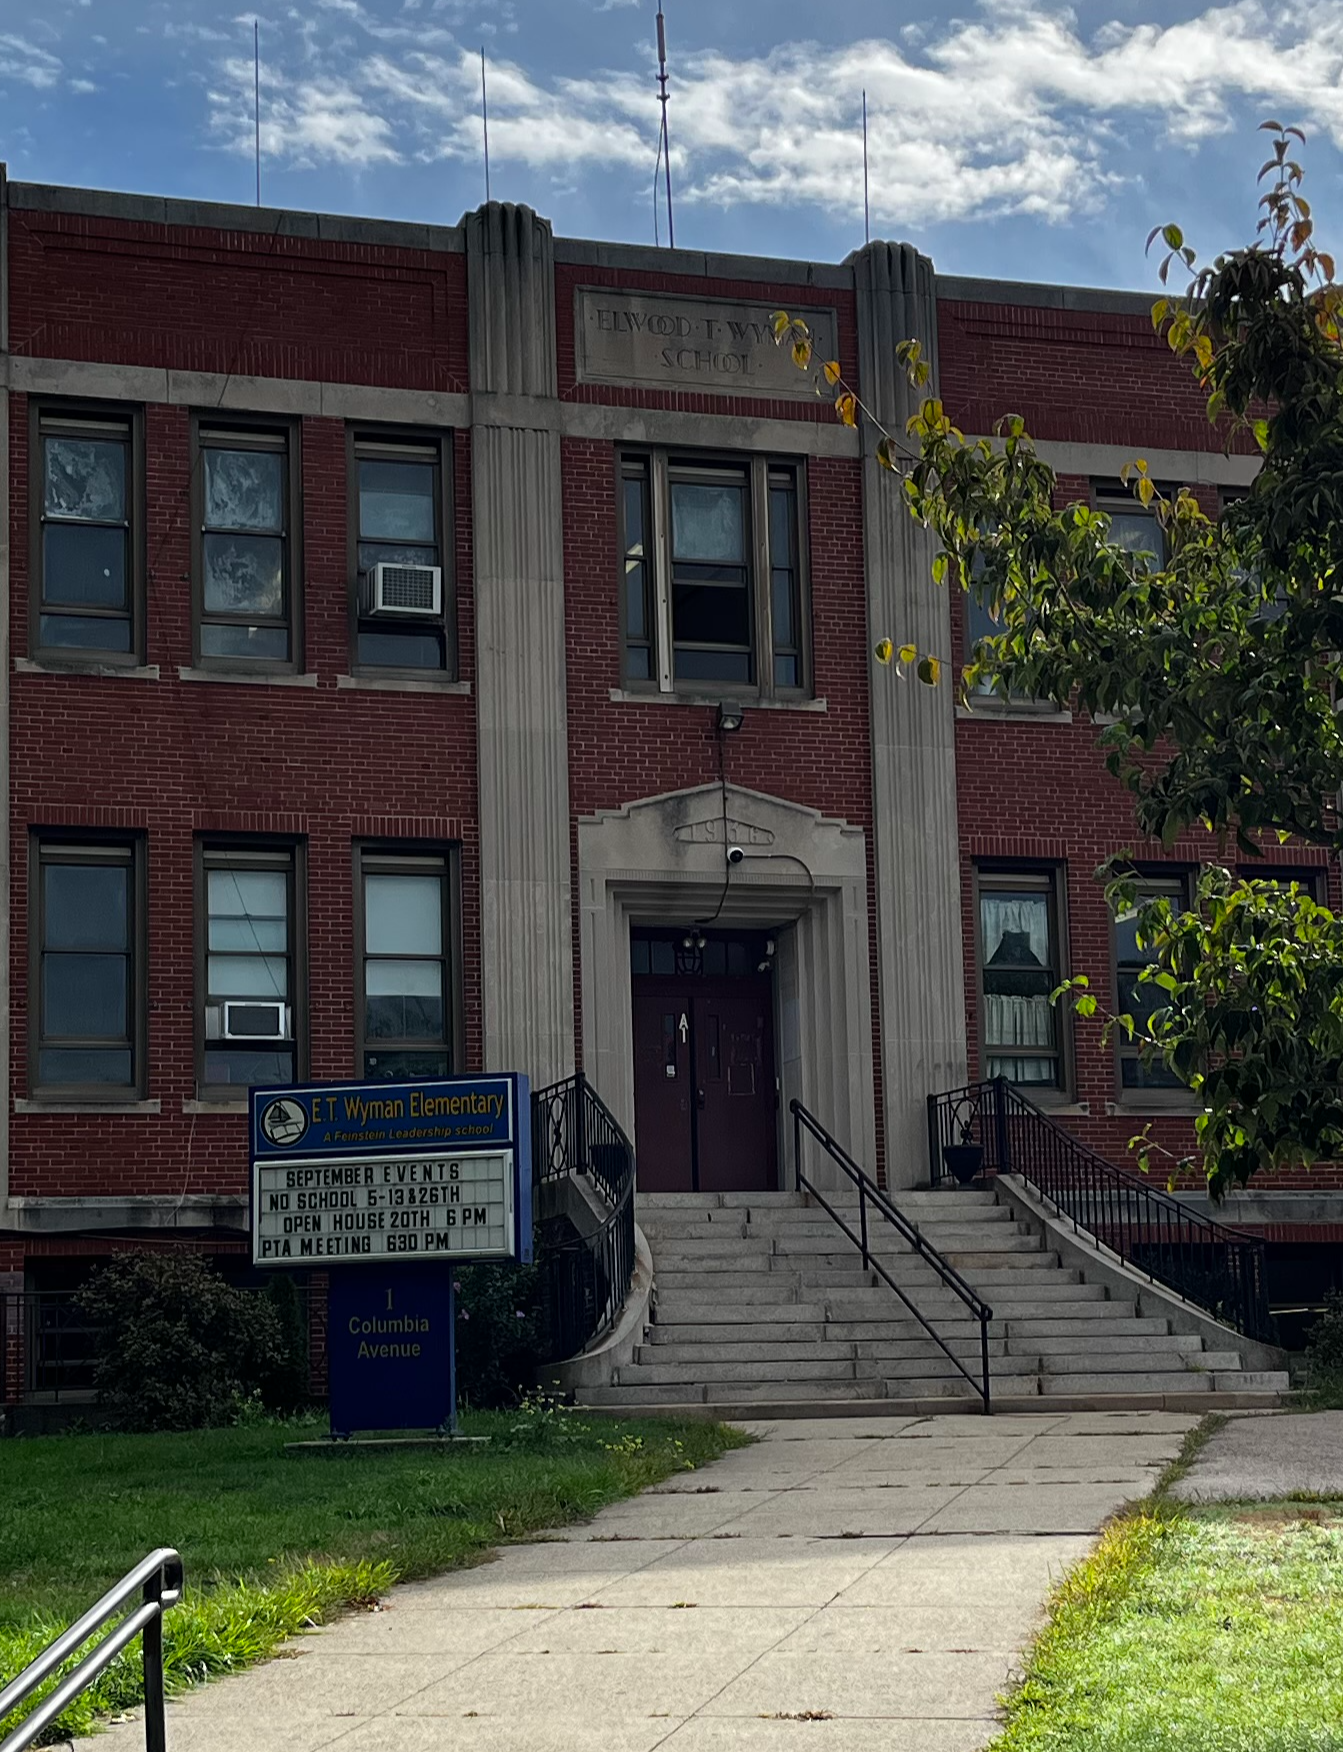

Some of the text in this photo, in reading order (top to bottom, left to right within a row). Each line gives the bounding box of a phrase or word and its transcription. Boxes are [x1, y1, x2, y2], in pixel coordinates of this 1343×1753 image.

[596, 308, 692, 338] ELWOOD
[660, 349, 755, 374] SCHOOL
[343, 1096, 404, 1126] Wyman
[410, 1092, 503, 1119] Elementary
[323, 1123, 494, 1142] A Feinstein Leadership school
[286, 1163, 460, 1188] SEPTEMBER EVENTS
[269, 1193, 289, 1211] NO
[297, 1190, 357, 1210] SCHOOL
[283, 1207, 487, 1234] OPEN HOUSE 20TH 6 PM
[262, 1231, 449, 1257] PTA MEETING 630 PM
[348, 1314, 430, 1334] Columbia
[357, 1340, 421, 1359] Avenue
